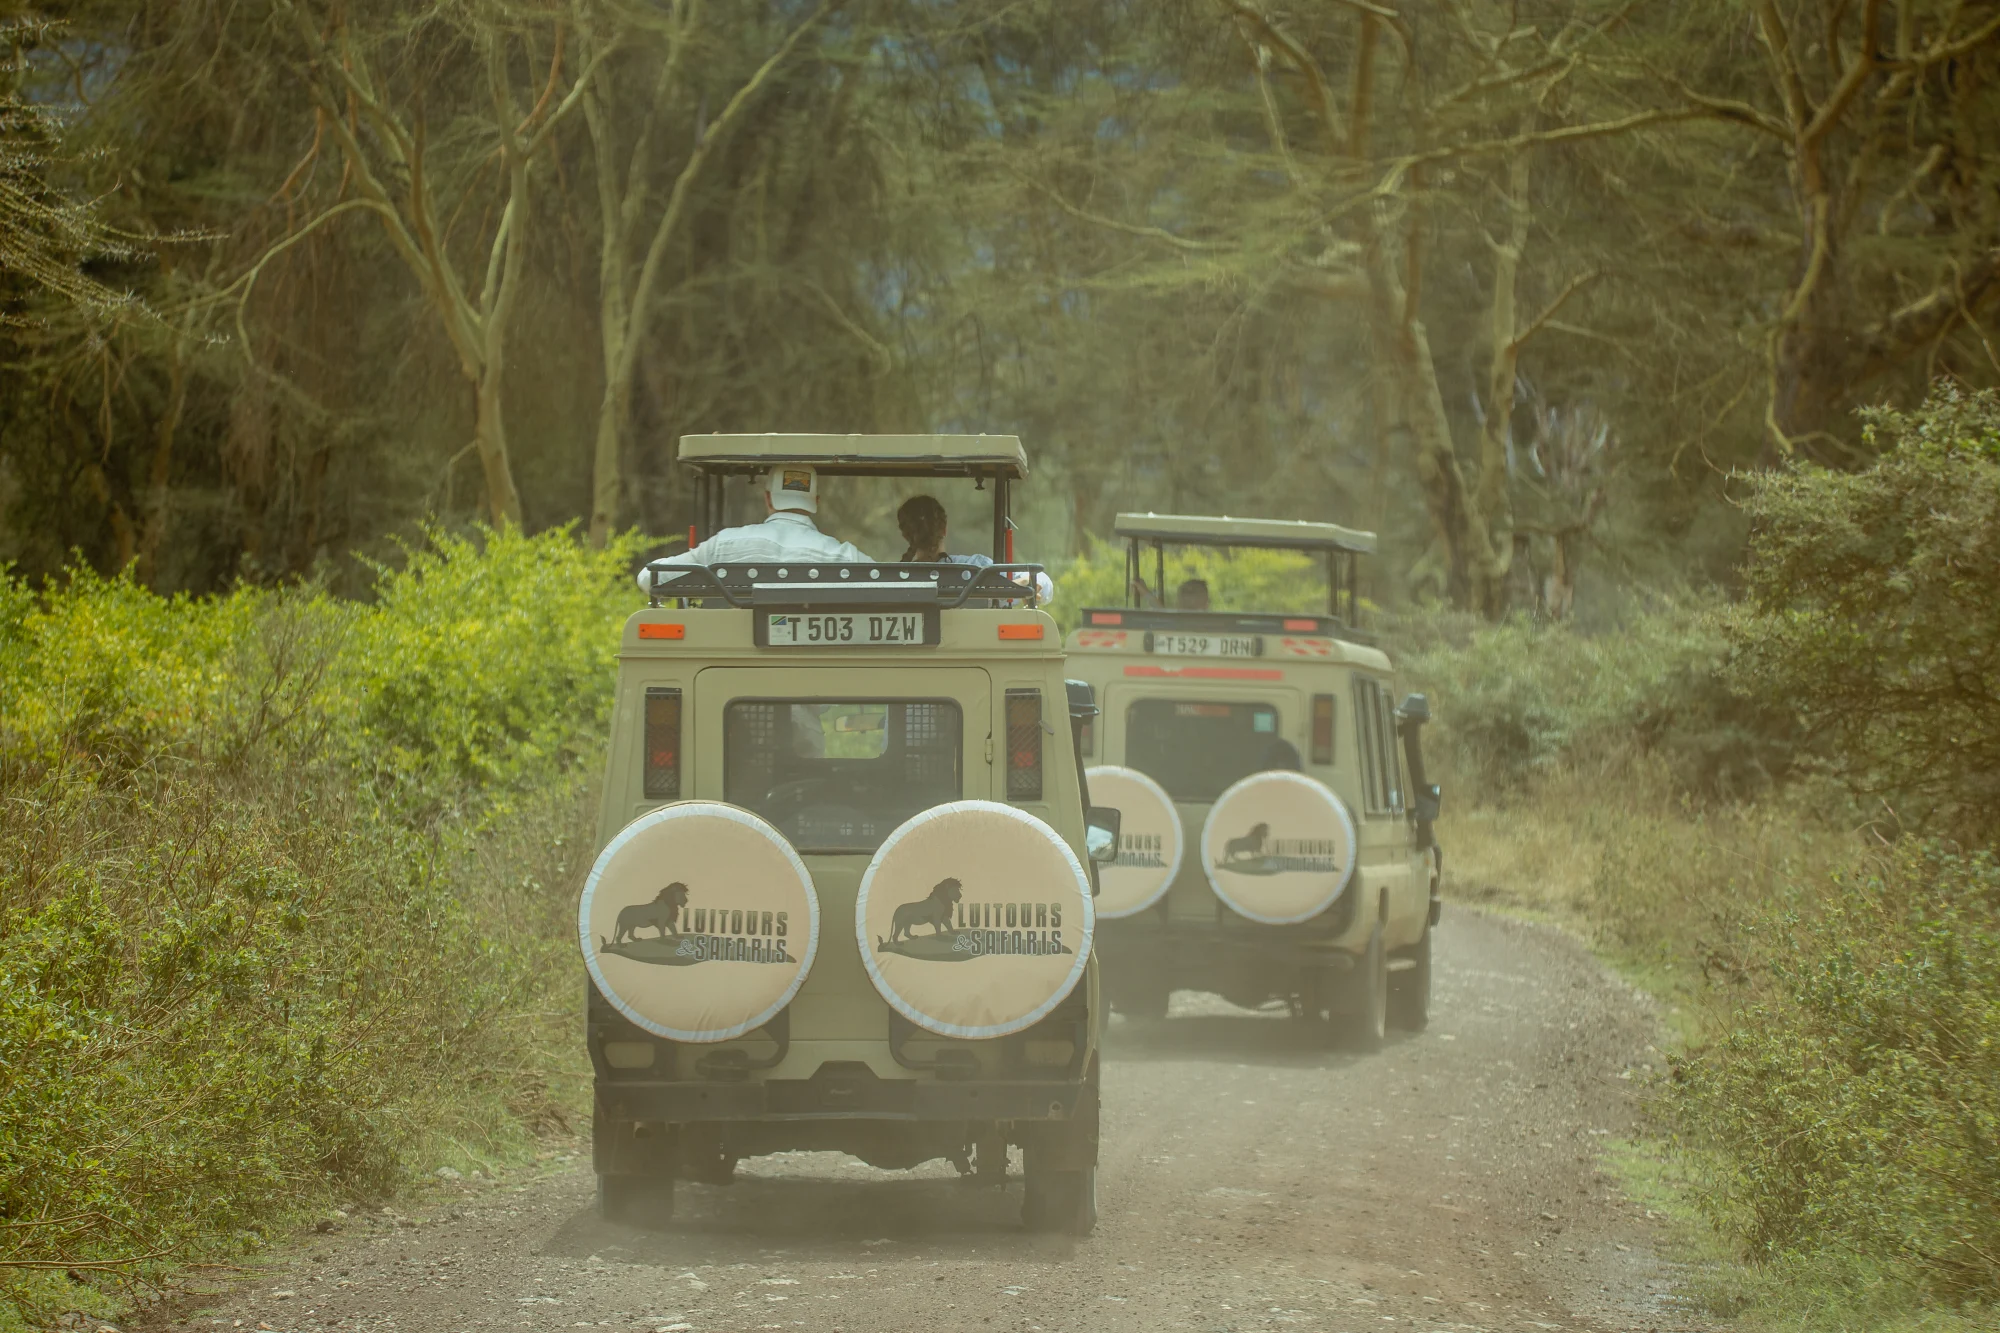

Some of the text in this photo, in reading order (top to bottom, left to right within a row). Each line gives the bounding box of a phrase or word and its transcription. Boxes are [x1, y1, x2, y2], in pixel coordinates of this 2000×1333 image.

[788, 616, 916, 641] T 503 DZW
[1178, 638, 1207, 654] 529
[683, 908, 788, 937] LUITOURS
[957, 902, 1062, 928] LUITOURS
[676, 935, 787, 963] & SAFARIS
[952, 929, 1062, 955] & SAFARIS
